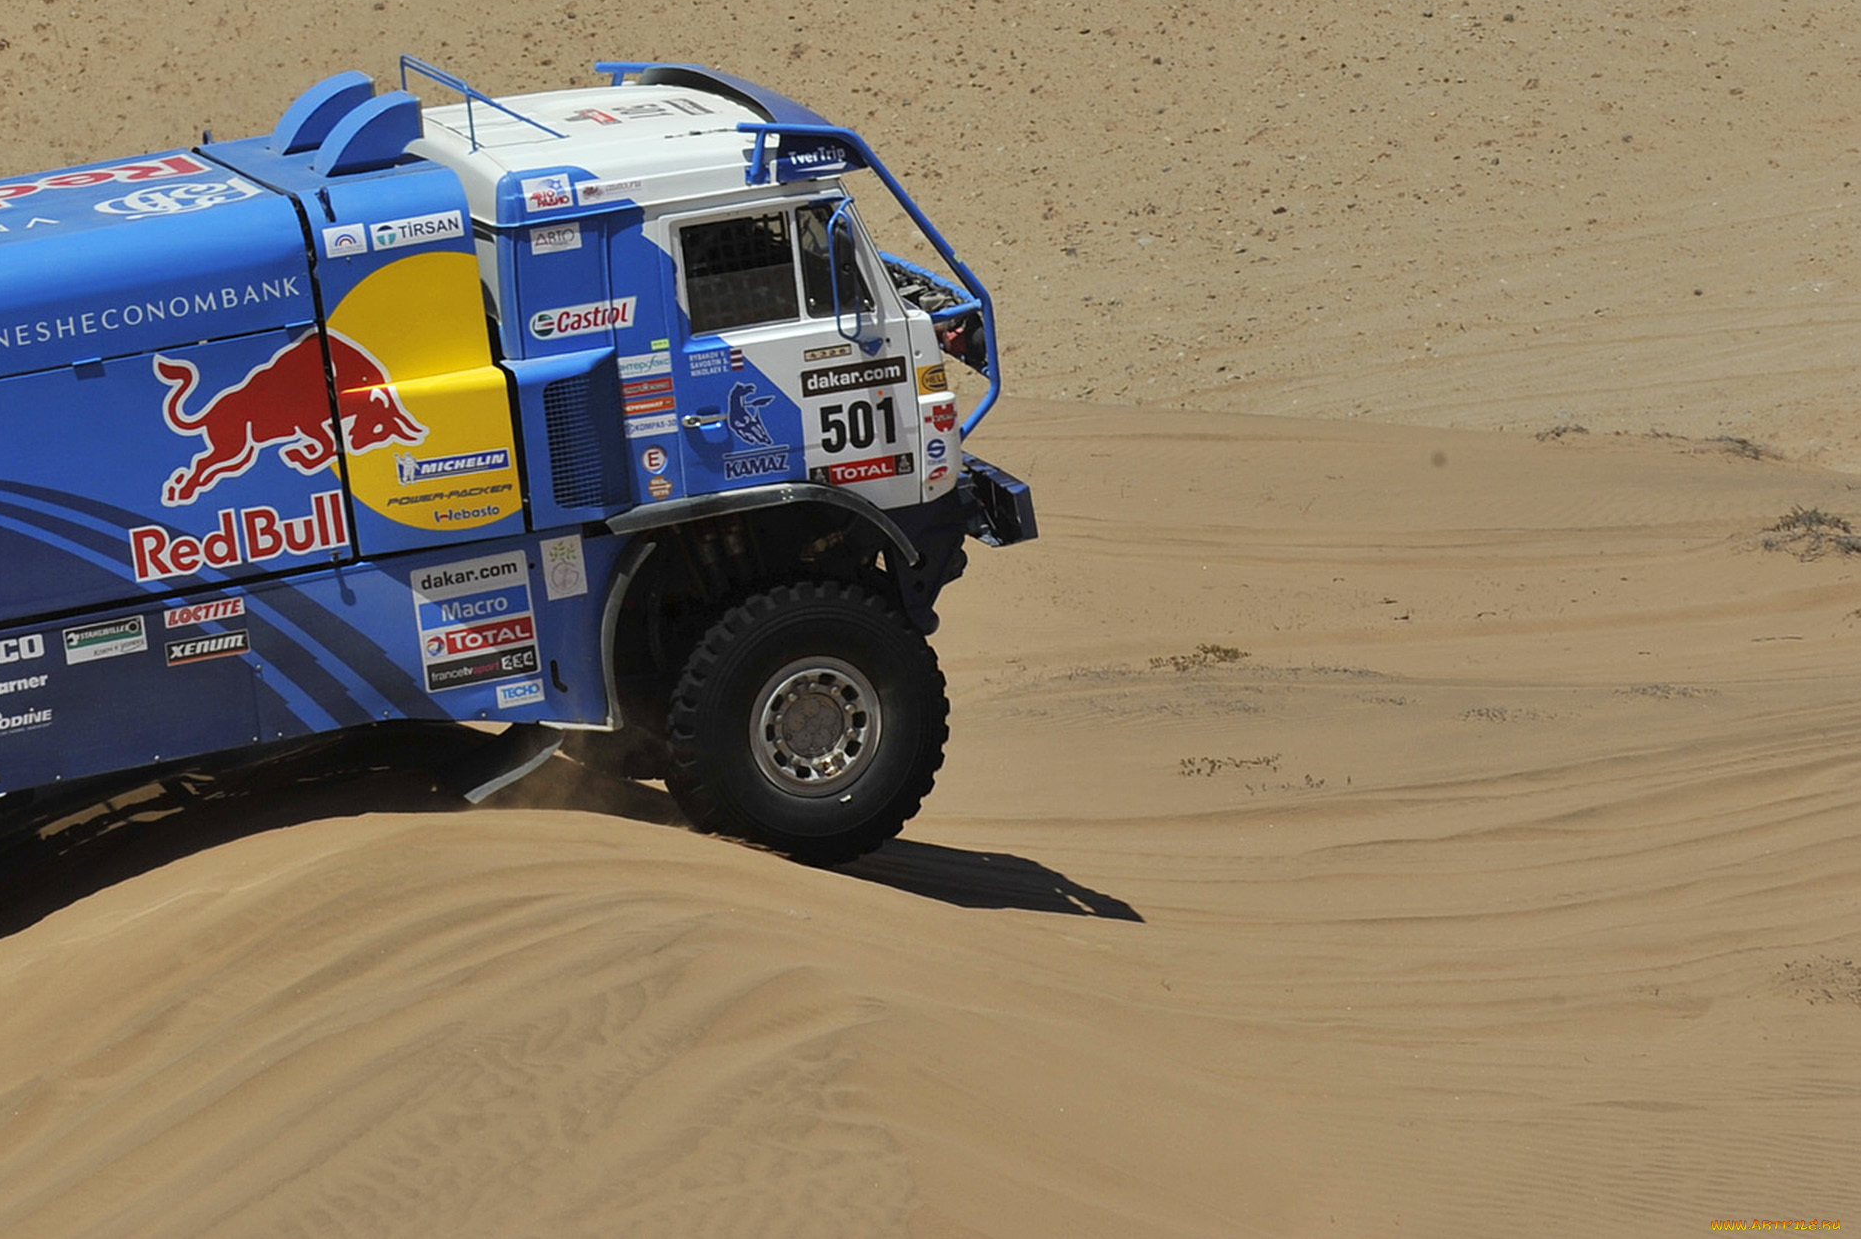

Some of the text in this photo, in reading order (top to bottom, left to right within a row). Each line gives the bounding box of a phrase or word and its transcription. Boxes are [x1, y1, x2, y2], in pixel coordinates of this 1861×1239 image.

[557, 302, 628, 333] Castrol
[807, 365, 901, 390] dakar.com
[820, 396, 896, 453] 501
[421, 453, 505, 474] MICHELIN
[725, 453, 789, 480] KAMAZ
[832, 463, 893, 481] TOTAL
[130, 490, 348, 581] Red Bull
[421, 562, 518, 590] dakar.com
[168, 599, 241, 626] LOCTITE
[442, 597, 509, 622] Macro
[449, 625, 531, 650] TOTAL
[502, 683, 541, 699] TECHO
